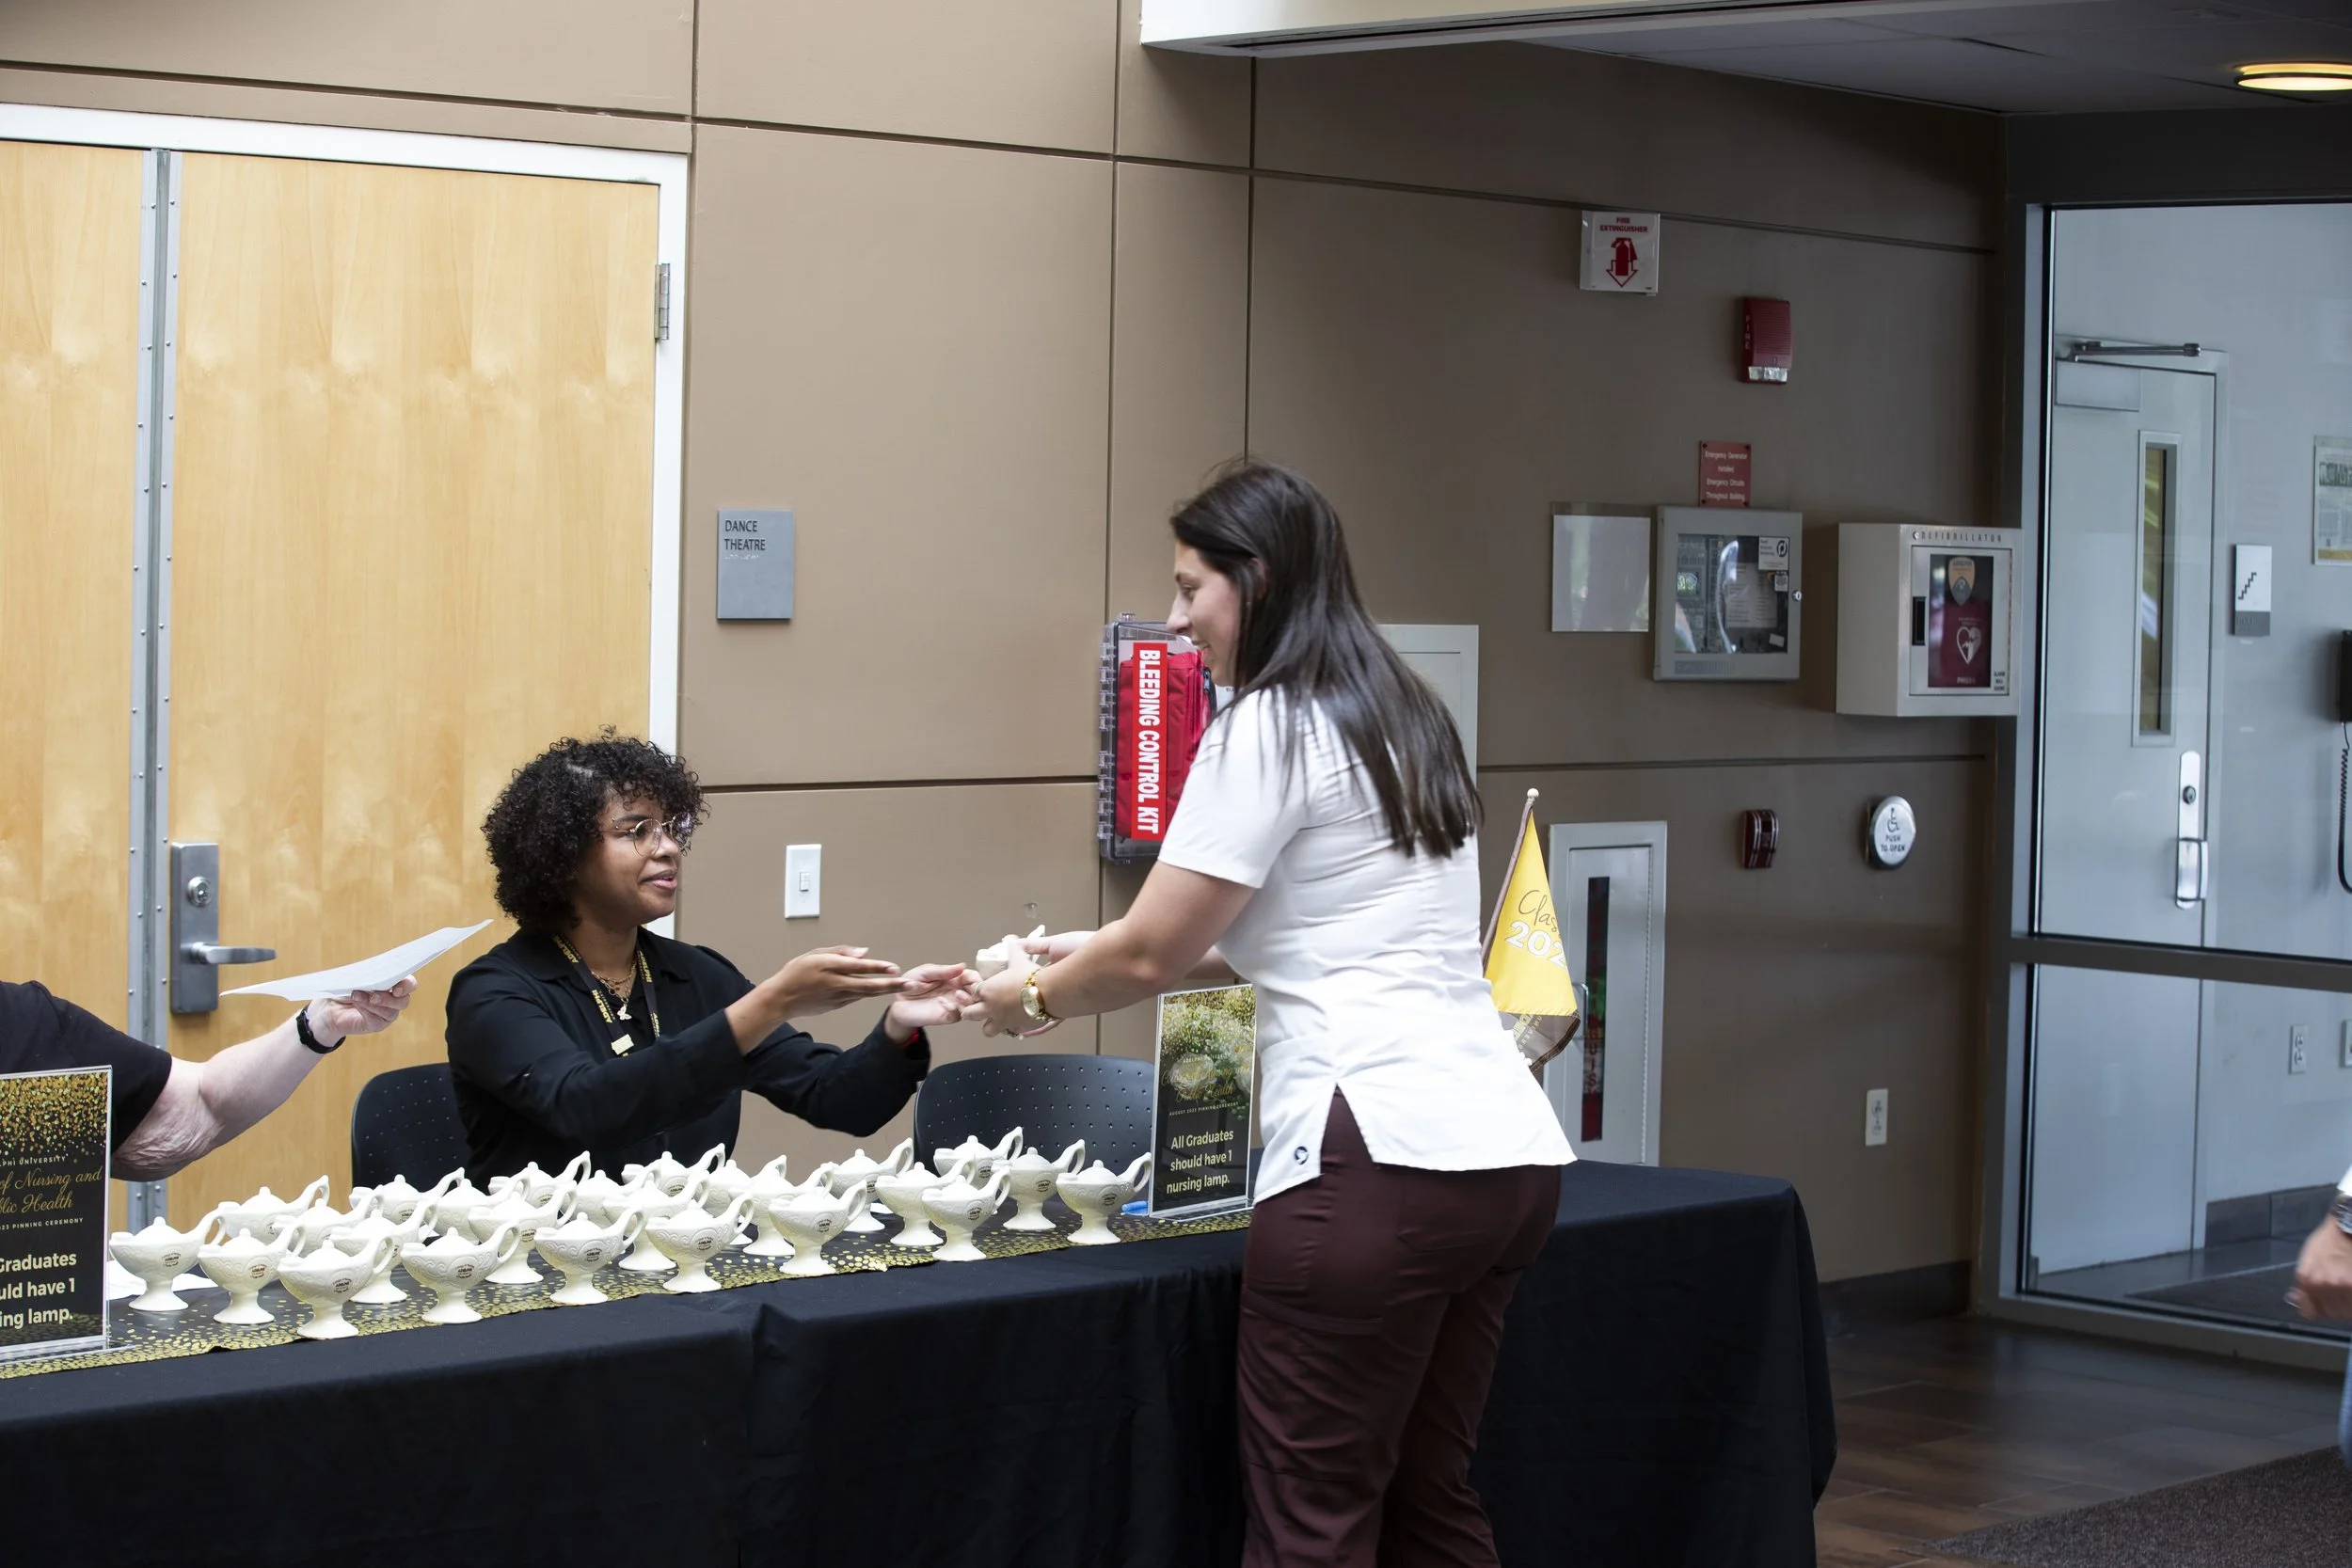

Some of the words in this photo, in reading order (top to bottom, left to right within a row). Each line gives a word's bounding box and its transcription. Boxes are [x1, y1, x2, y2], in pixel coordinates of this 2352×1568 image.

[1599, 225, 1647, 233] EXTINGUISHER
[724, 519, 758, 532] DANCE
[723, 538, 766, 550] THEATRE
[1921, 531, 2002, 542] DEFIBRILLATOR
[1139, 649, 1161, 726] BLEEDING
[1137, 730, 1160, 803] CONTROL
[1137, 806, 1159, 833] KIT
[1518, 890, 1561, 938] Clas
[592, 989, 612, 1023] ADELPHI
[1170, 1135, 1184, 1149] All
[1185, 1130, 1234, 1147] Graduates
[19, 1156, 66, 1165] UNIVERSITY
[1169, 1153, 1202, 1171] should
[1204, 1152, 1227, 1165] have
[1228, 1149, 1232, 1162] 1
[14, 1167, 72, 1193] Nursing
[75, 1166, 103, 1183] and
[1167, 1177, 1202, 1195] nursing
[1204, 1174, 1230, 1187] lamp.
[21, 1190, 73, 1213] Health
[45, 1217, 84, 1226] CEREMONY
[27, 1281, 66, 1297] have
[68, 1277, 75, 1292] 1
[28, 1308, 73, 1324] lamp.
